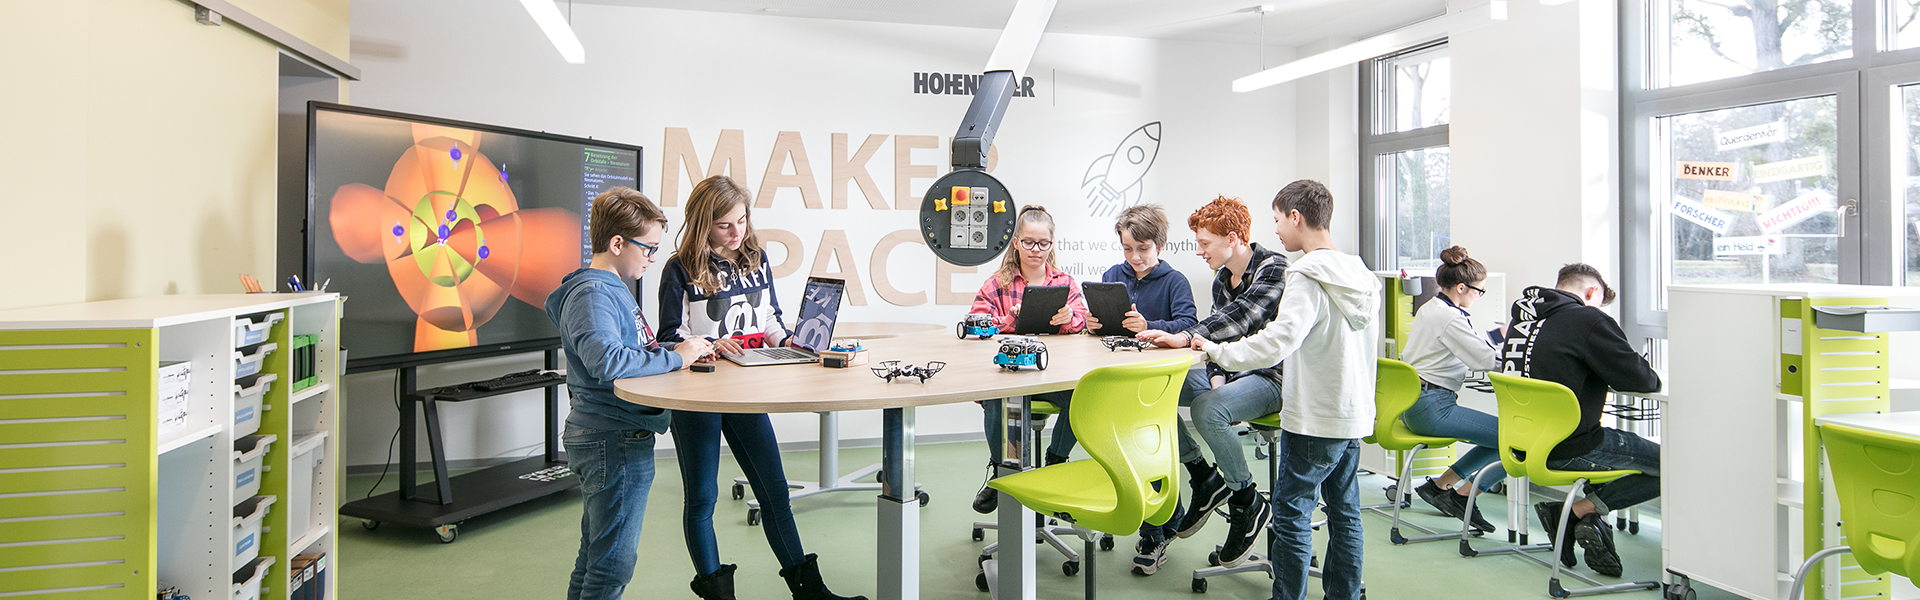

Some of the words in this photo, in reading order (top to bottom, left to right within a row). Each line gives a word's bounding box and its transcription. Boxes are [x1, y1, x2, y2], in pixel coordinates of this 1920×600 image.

[1720, 128, 1778, 146] Querdenker
[584, 151, 590, 162] 7
[660, 127, 999, 210] MAKE
[1684, 165, 1730, 177] DENKER
[1754, 160, 1824, 179] EINZIGARTIG
[1718, 196, 1751, 208] Freund
[1673, 201, 1726, 229] FORSCHER
[1762, 197, 1822, 229] WICHTIG!!!
[1058, 238, 1085, 251] that
[1088, 240, 1107, 251] we
[1162, 239, 1198, 254] nythi
[1717, 243, 1730, 252] ein
[1733, 242, 1754, 251] Held
[752, 228, 980, 307] PACE
[1061, 263, 1084, 275] will
[693, 262, 769, 295] MCKEY
